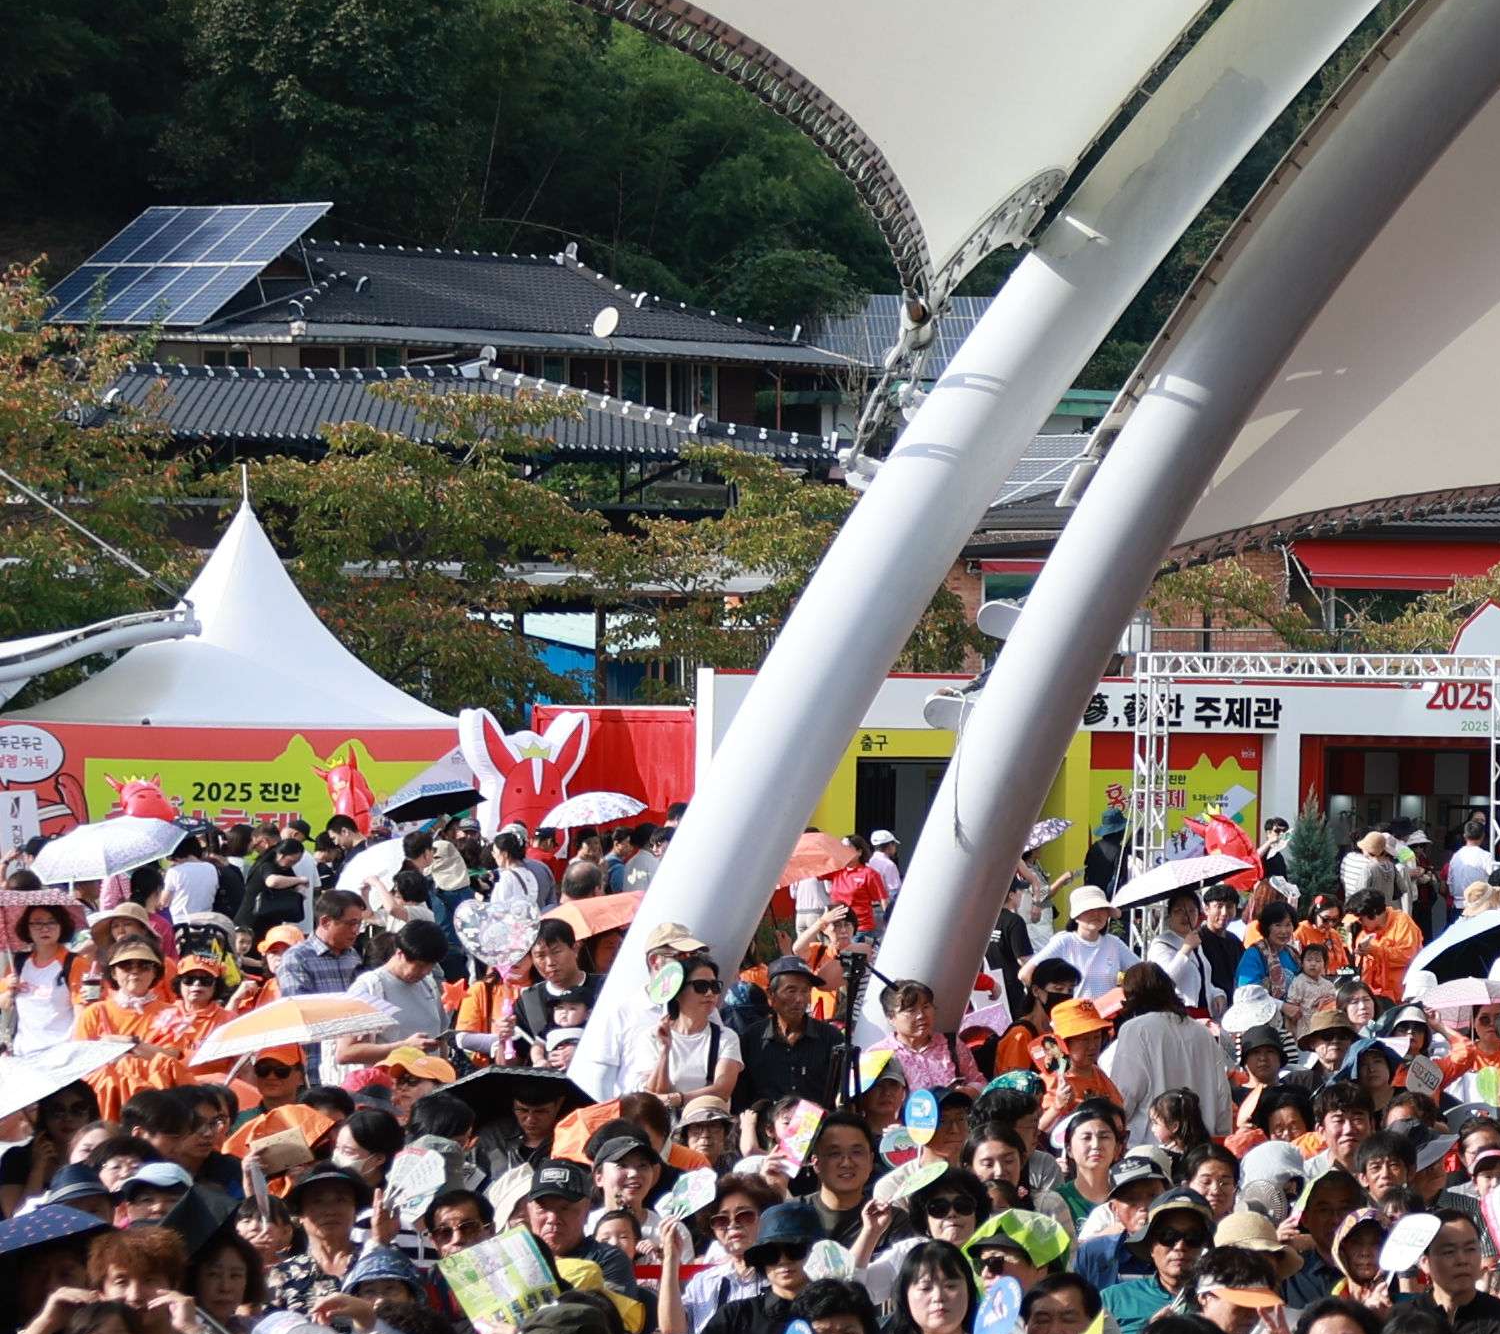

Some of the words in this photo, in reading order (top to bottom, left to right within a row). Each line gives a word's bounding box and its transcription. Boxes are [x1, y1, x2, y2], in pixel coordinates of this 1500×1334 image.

[1426, 681, 1492, 711] 2025
[1194, 695, 1281, 728] 주제관
[1461, 722, 1488, 733] 2025
[860, 734, 889, 752] 출구
[192, 782, 252, 802] 2025
[259, 782, 302, 802] 진안
